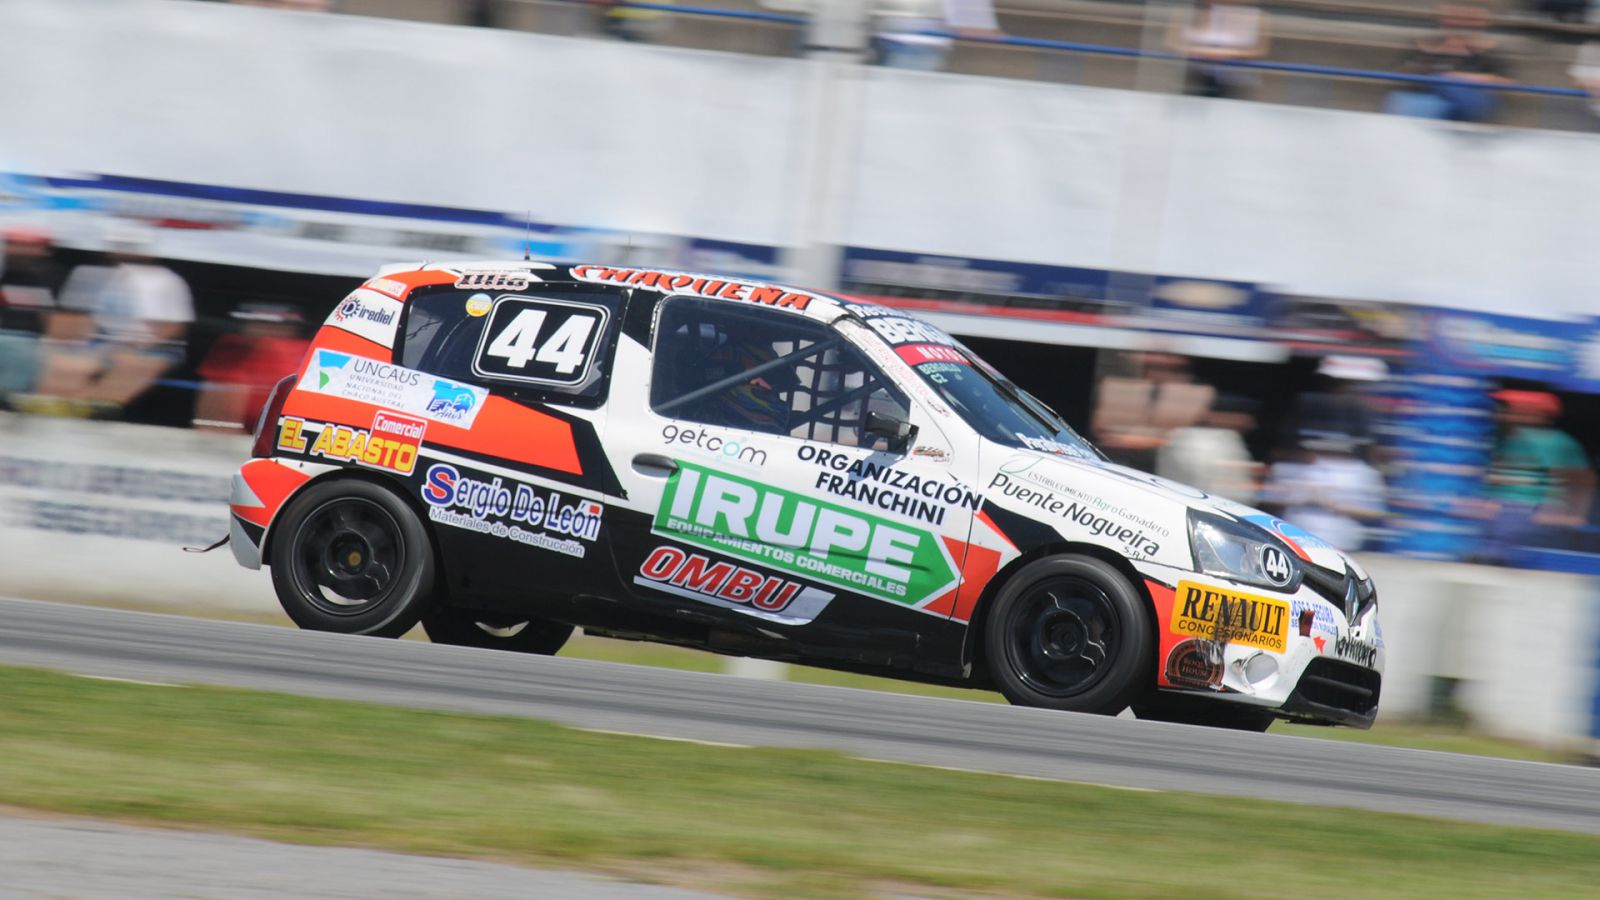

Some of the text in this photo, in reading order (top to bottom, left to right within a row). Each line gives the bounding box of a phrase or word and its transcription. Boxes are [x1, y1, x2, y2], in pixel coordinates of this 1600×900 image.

[487, 308, 596, 374] 44
[345, 382, 386, 395] NACIONAL
[350, 374, 404, 391] UNIVERSIDAD
[354, 359, 421, 386] UNCAUS
[342, 389, 405, 409] CHACO AUSTRAL
[279, 418, 417, 473] EL ABASTO
[374, 415, 424, 439] Comercial
[662, 424, 767, 466] getcom
[797, 444, 983, 511] ORGANIZACIÓN
[815, 472, 946, 526] FRANCHINI
[1027, 471, 1093, 503] ESTABLECIMIENTO
[423, 466, 602, 539] Sergio De León
[670, 468, 920, 583] IRUPE
[988, 472, 1160, 557] Puente Nogueira
[430, 507, 584, 556] Materiales de Construcción
[641, 546, 799, 611] OMBU
[666, 518, 906, 596] EQUIPAMIENTOS COMERCIALES
[1266, 549, 1289, 579] 44
[1178, 619, 1282, 649] CONCESIONARIOS
[1181, 587, 1285, 636] RENAULT
